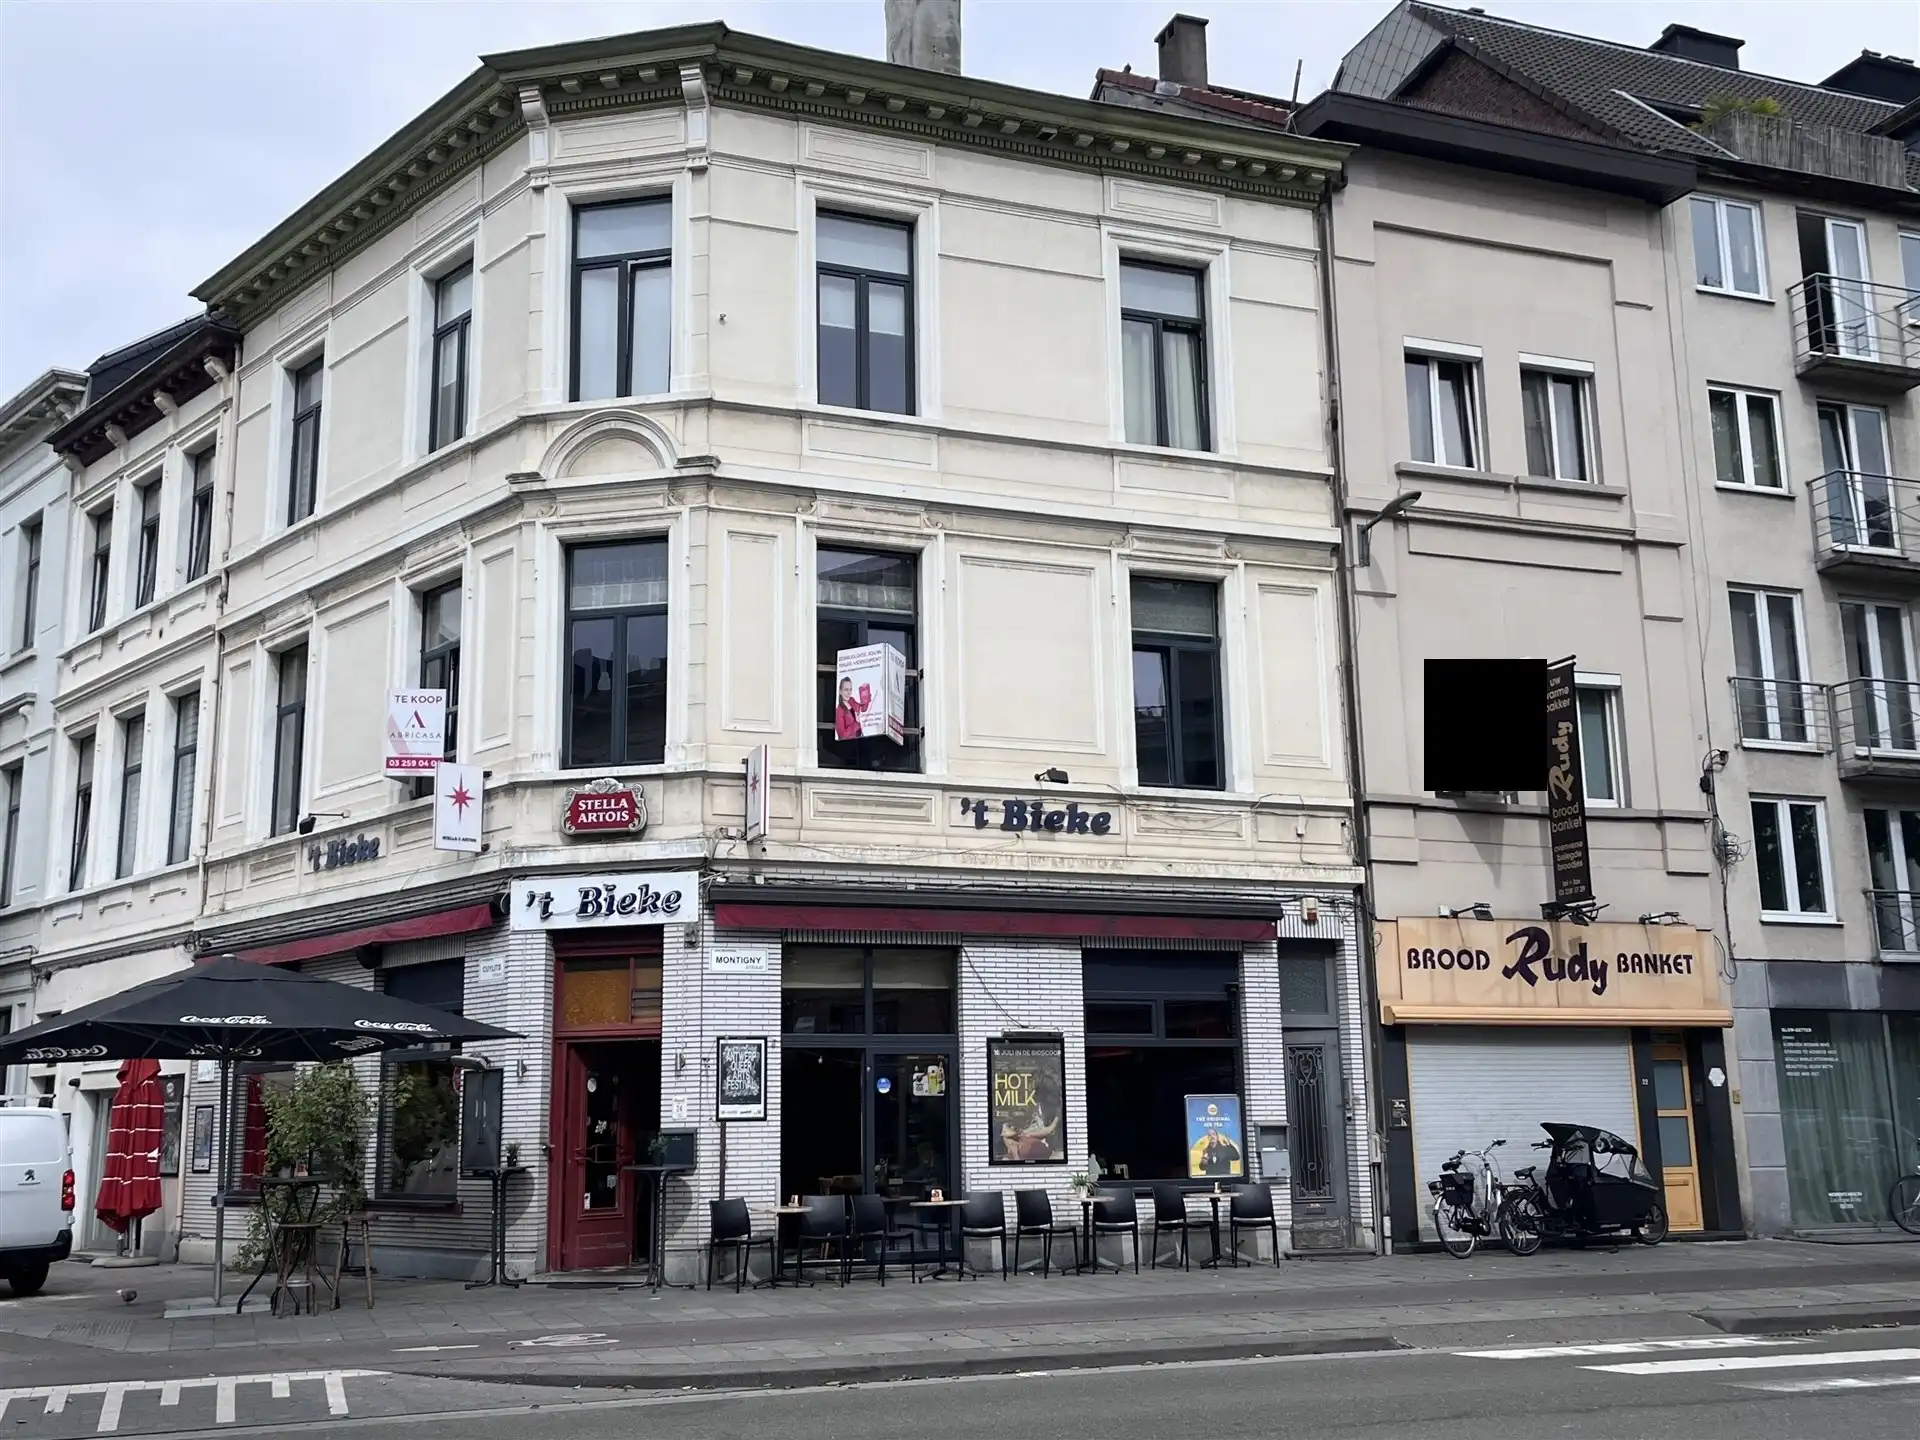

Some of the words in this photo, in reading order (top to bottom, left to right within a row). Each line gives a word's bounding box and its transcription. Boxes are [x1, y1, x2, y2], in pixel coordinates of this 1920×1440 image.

[394, 694, 408, 704] TE
[410, 695, 443, 704] KOOP
[390, 731, 442, 739] ABRICASA
[388, 758, 400, 767] 03
[400, 758, 417, 767] 259
[431, 758, 441, 767] 0
[1548, 721, 1574, 801] Rudy
[578, 798, 629, 811] STELLA
[1552, 802, 1580, 818] brood
[577, 811, 630, 823] ARTOIS
[1000, 800, 1112, 836] Bieke
[1552, 816, 1583, 833] banket
[324, 833, 380, 870] Bieke
[575, 883, 683, 920] Bieke
[715, 956, 762, 964] MONTIGNY
[1407, 948, 1491, 970] BROOD
[1502, 926, 1609, 996] Rudy
[1617, 953, 1694, 975] BANKET
[179, 1015, 273, 1025] Coca-Cola
[354, 1019, 438, 1032] Coca-Cola
[726, 1050, 757, 1061] ANTWERP
[730, 1061, 752, 1071] QUEER
[732, 1071, 751, 1080] ARTS
[994, 1073, 1033, 1090] HOT
[727, 1079, 756, 1090] FESTIVAL
[995, 1090, 1038, 1106] MILK
